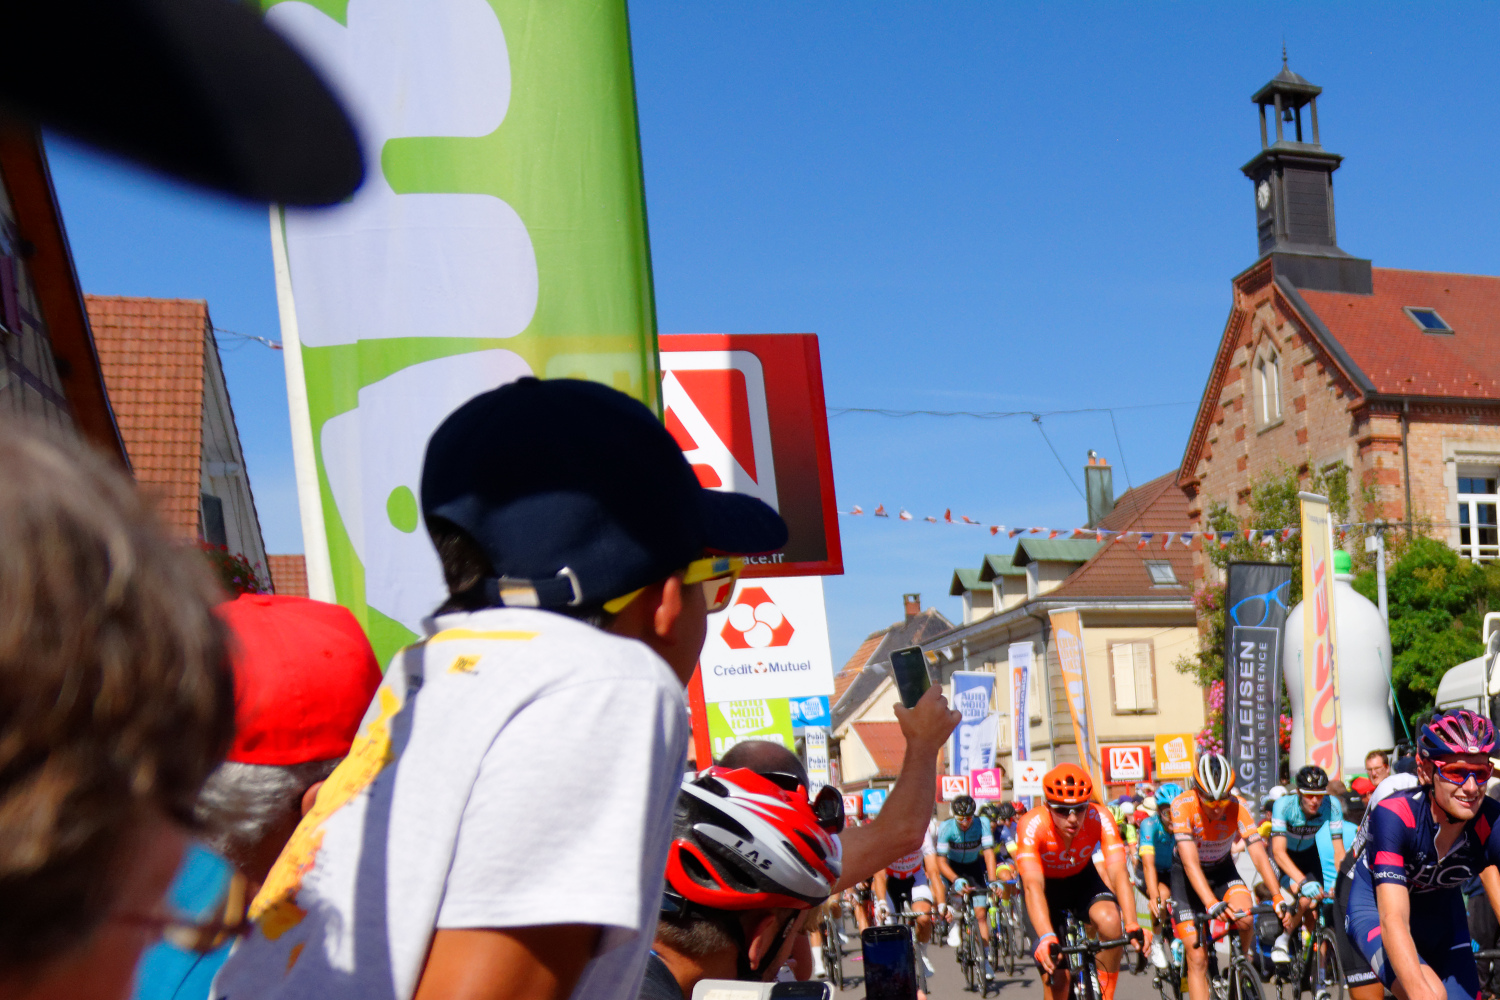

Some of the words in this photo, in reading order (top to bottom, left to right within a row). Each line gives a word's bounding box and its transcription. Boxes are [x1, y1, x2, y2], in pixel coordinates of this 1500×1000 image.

[713, 662, 753, 677] Crédit
[768, 660, 811, 674] Mutuel
[1257, 641, 1268, 731] RÉFÉRENCE
[961, 692, 985, 701] AUTO
[729, 707, 765, 717] MOTO
[961, 701, 985, 709] MOTO
[731, 717, 765, 730] ECOLE
[1239, 640, 1255, 817] NAGELEISEN
[1160, 760, 1191, 770] LARGER
[734, 839, 773, 871] LAS
[1041, 845, 1092, 863] CCC
